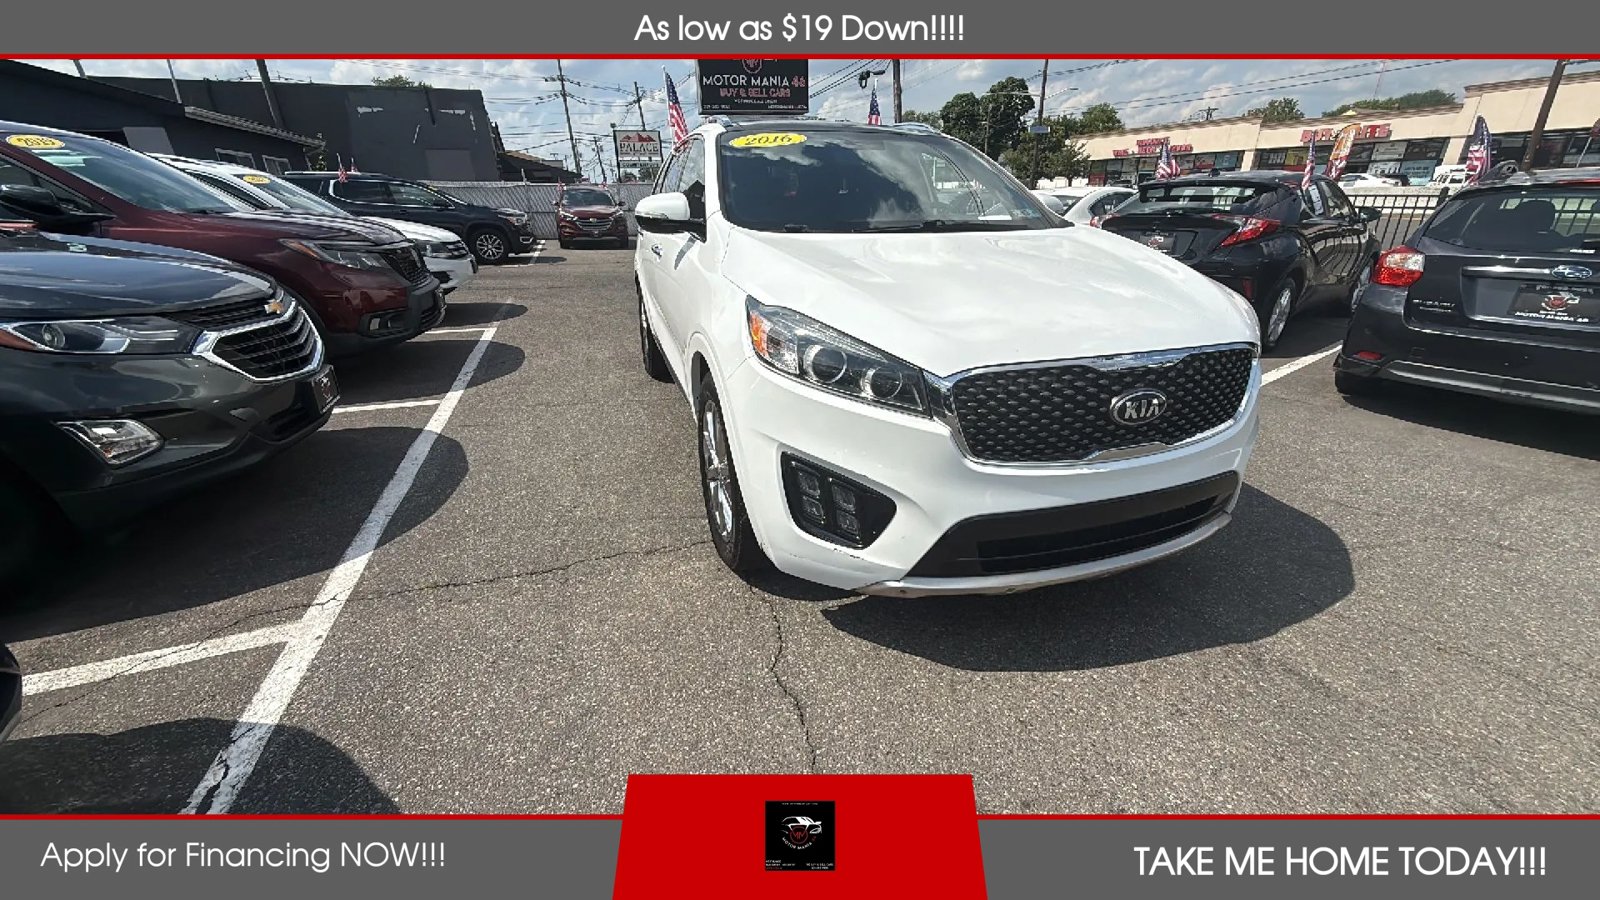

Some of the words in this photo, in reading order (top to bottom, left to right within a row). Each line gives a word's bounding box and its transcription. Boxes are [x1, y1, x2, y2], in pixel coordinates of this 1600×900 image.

[703, 74, 747, 86] MOTOR
[751, 75, 790, 87] MANIA
[719, 88, 738, 97] BUY
[748, 88, 768, 98] SELL
[769, 88, 791, 98] CARS
[744, 134, 793, 146] 2016
[619, 142, 659, 152] PALACE
[1124, 398, 1160, 419] KIA
